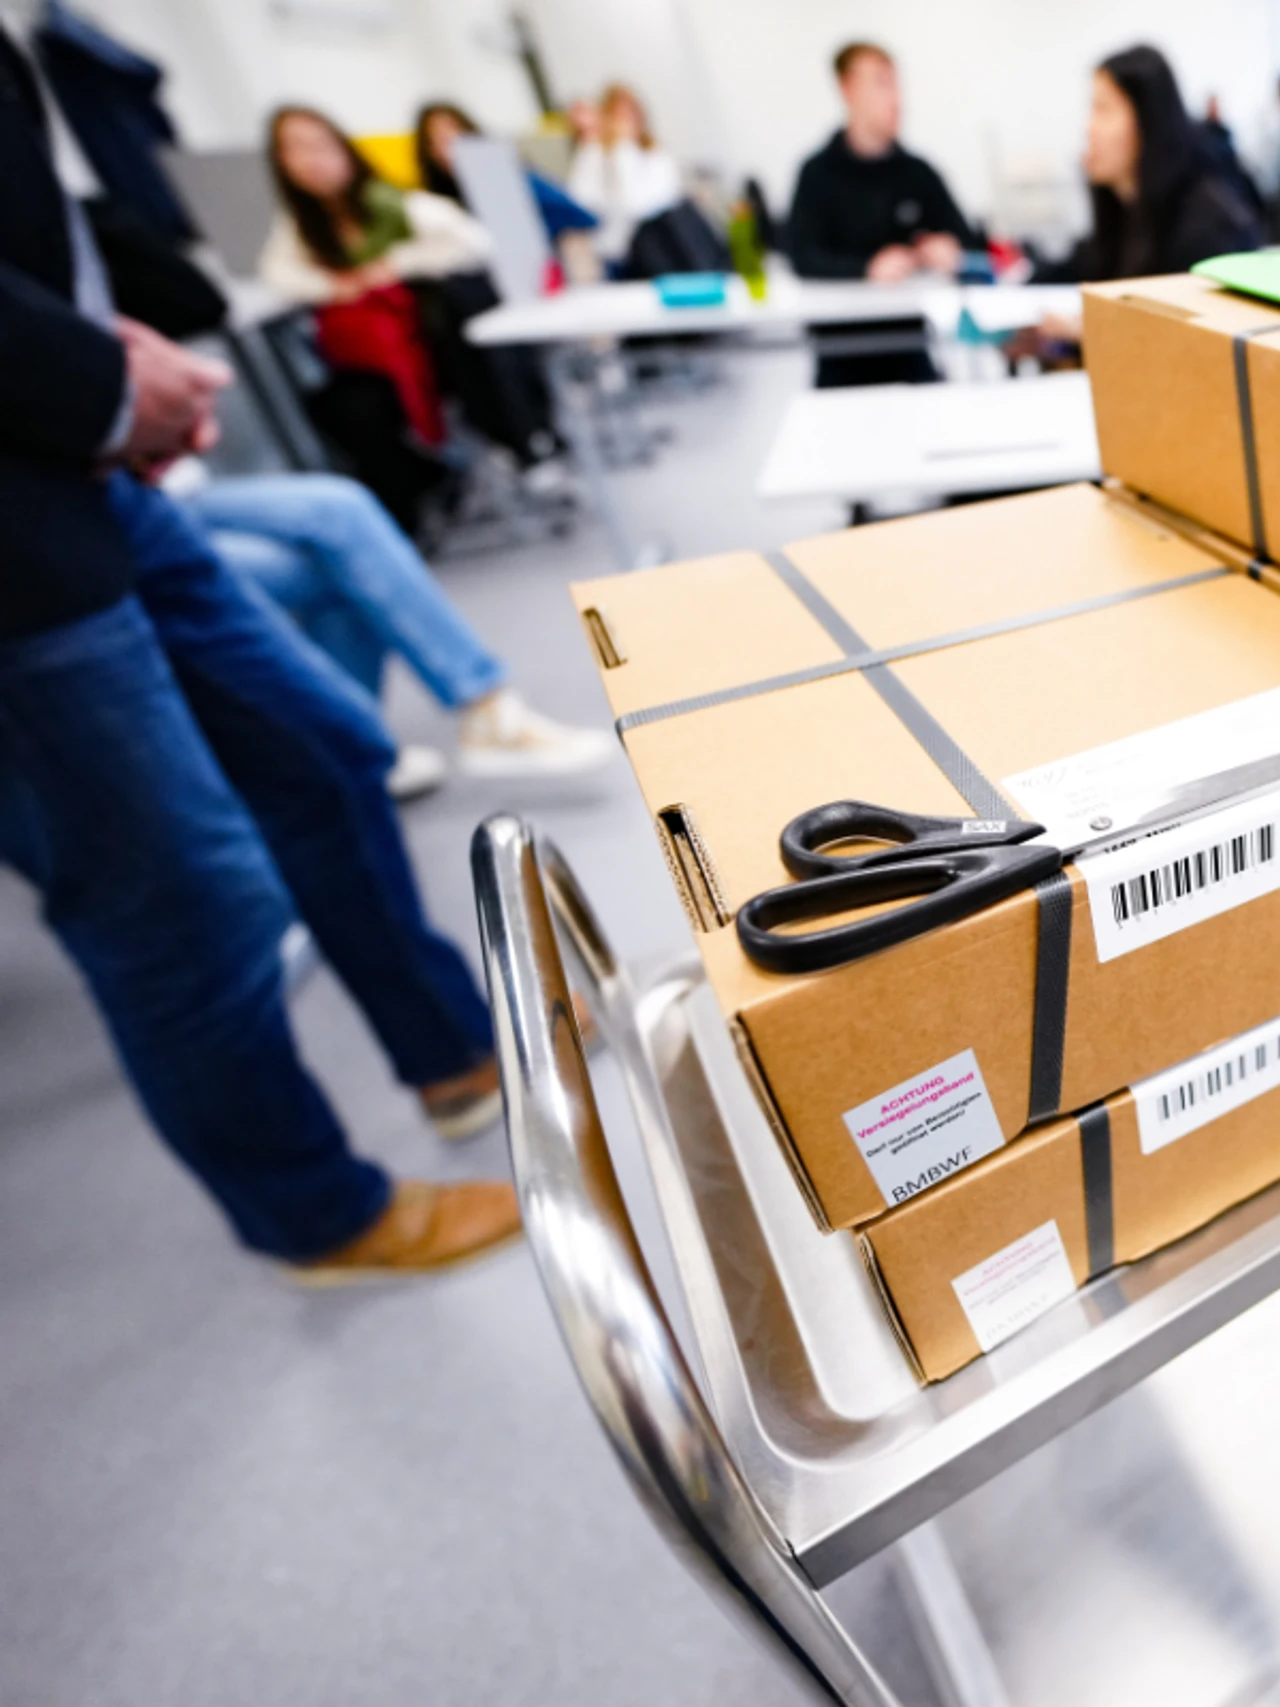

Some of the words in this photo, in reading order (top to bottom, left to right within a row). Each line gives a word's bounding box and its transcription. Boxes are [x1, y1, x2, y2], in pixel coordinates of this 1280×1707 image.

[856, 1071, 975, 1139] Versiegelungsband
[880, 1075, 945, 1115] ACHTUNG
[891, 1145, 972, 1203] BMBWF
